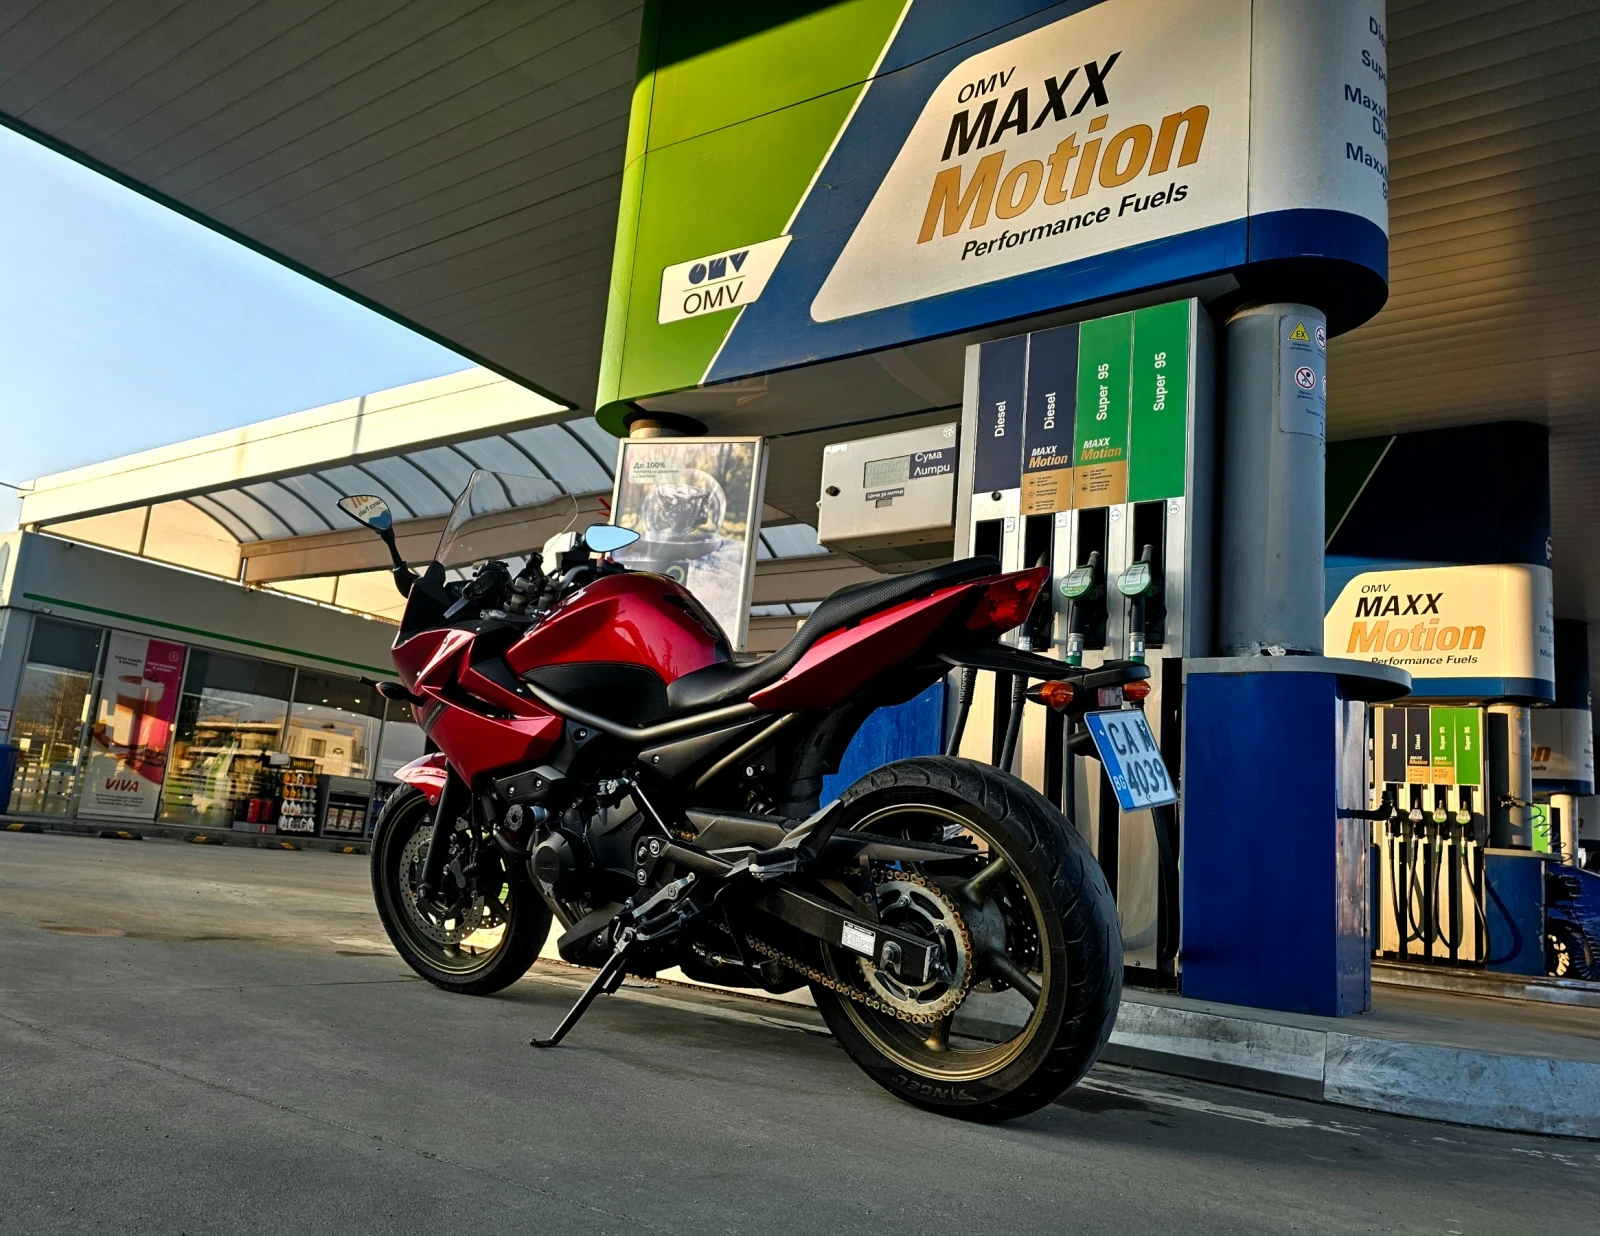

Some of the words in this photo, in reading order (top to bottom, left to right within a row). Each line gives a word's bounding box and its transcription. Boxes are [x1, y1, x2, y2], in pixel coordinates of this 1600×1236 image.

[957, 66, 1015, 103] OMV
[941, 51, 1122, 161] MAXX
[917, 104, 1210, 244] Motion
[961, 206, 1110, 261] Performance
[1117, 182, 1189, 218] Fuels
[683, 281, 743, 314] OMV
[1296, 330, 1306, 338] EX
[1155, 352, 1166, 368] 95
[1098, 363, 1109, 379] 95
[1153, 374, 1168, 411] Super
[1043, 392, 1056, 430] Diesel
[1096, 385, 1110, 421] Super
[994, 401, 1006, 437] Diesel
[1031, 445, 1057, 456] MAXX
[1083, 437, 1111, 449] MAXX
[915, 451, 942, 463] Сума
[1028, 453, 1068, 468] Motion
[1081, 446, 1122, 460] Motion
[646, 461, 665, 469] 100%
[914, 464, 950, 476] Литри
[1361, 584, 1391, 593] OMV
[1355, 592, 1444, 617] MAXX
[1346, 618, 1486, 653] Motion
[1371, 656, 1443, 665] Performance
[1446, 655, 1478, 664] Fuels
[1108, 721, 1140, 755] CA
[105, 778, 139, 792] VIVA
[1113, 775, 1127, 791] BG
[1126, 758, 1168, 797] 4039
